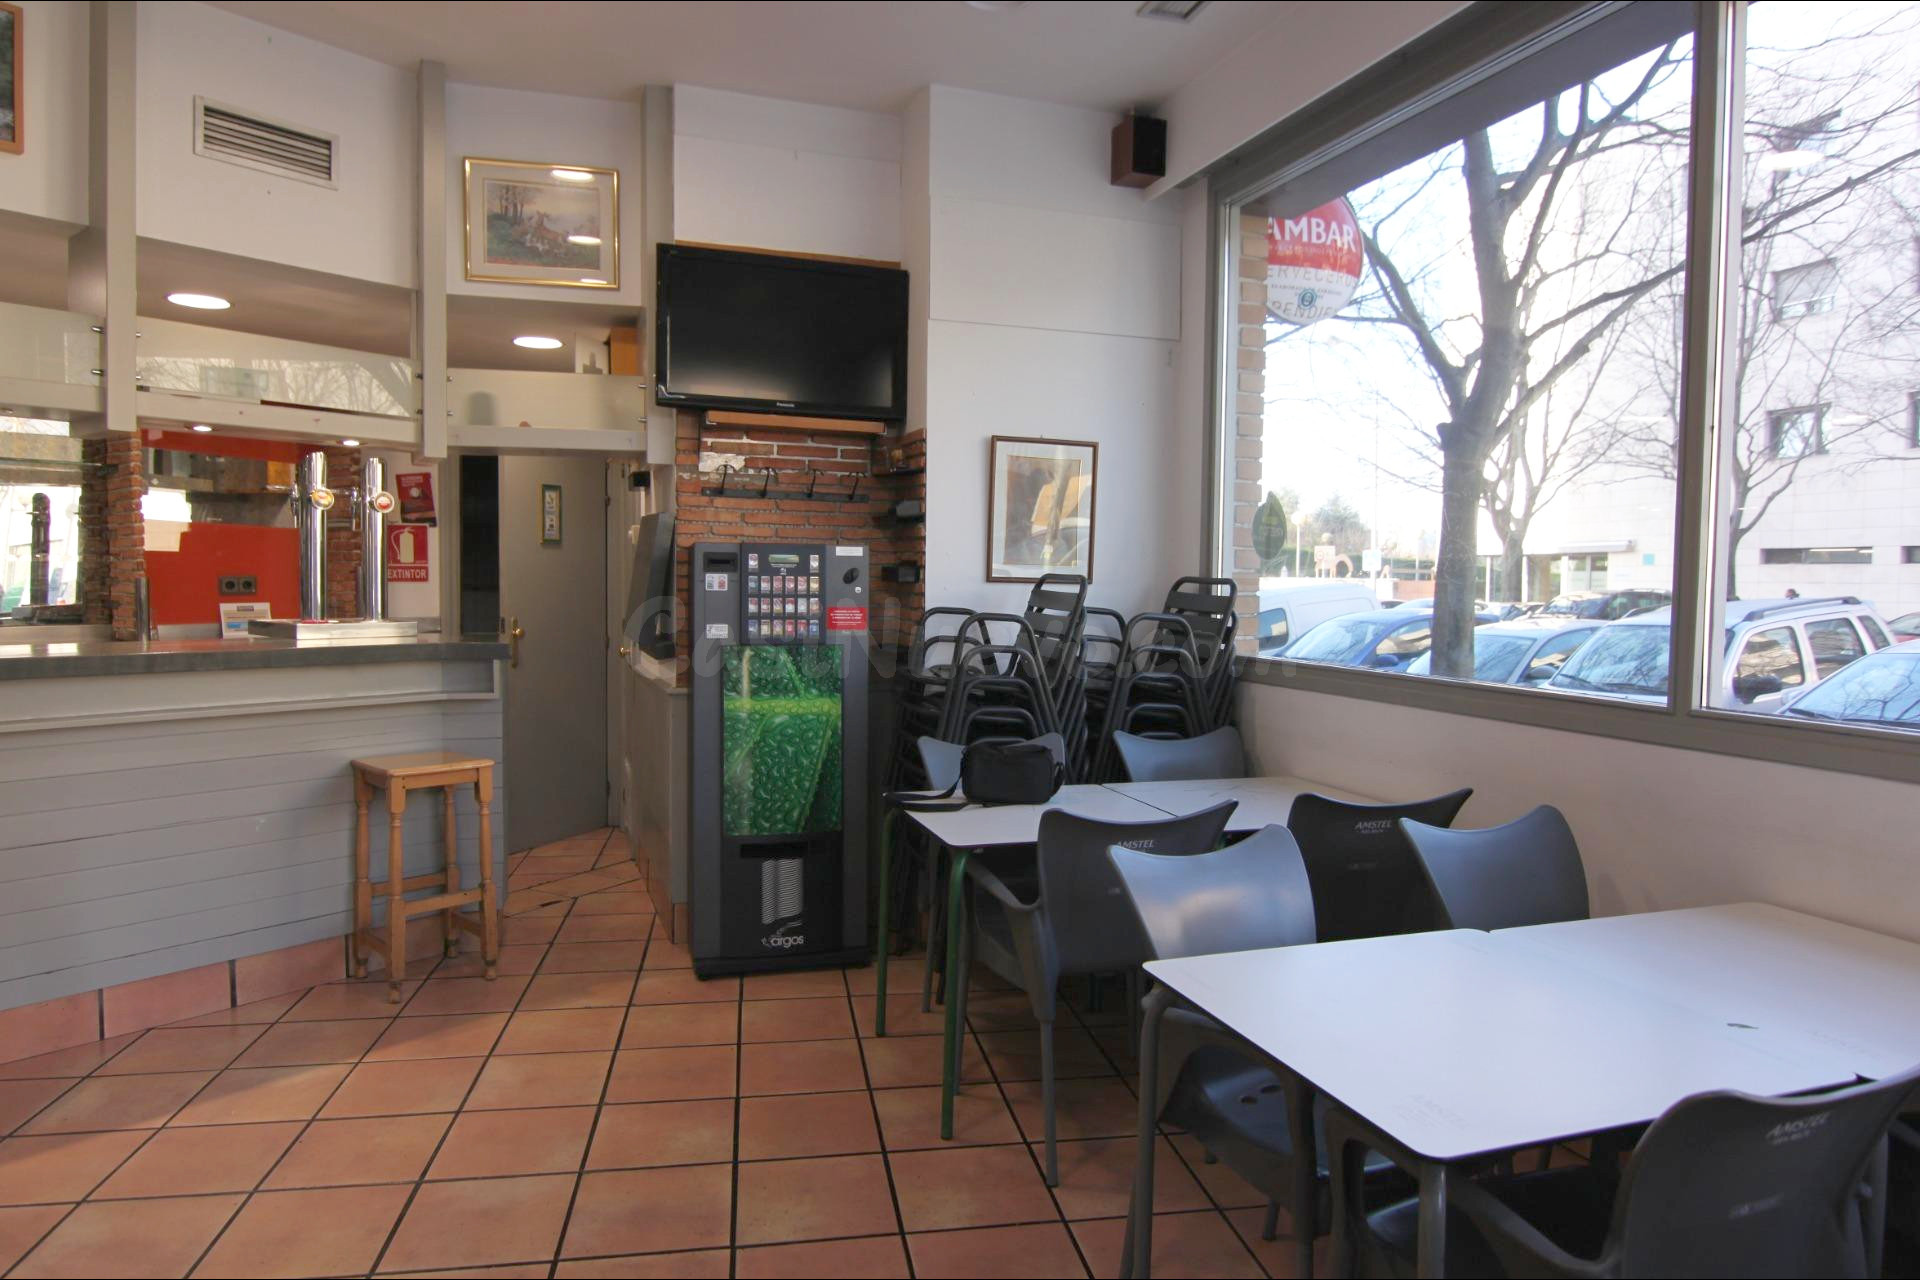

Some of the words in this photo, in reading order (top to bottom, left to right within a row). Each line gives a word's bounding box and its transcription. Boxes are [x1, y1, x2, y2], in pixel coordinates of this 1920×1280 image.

[1267, 216, 1357, 253] AMBAR
[388, 568, 427, 579] EXTINTOR
[1354, 820, 1392, 830] AMSTEL
